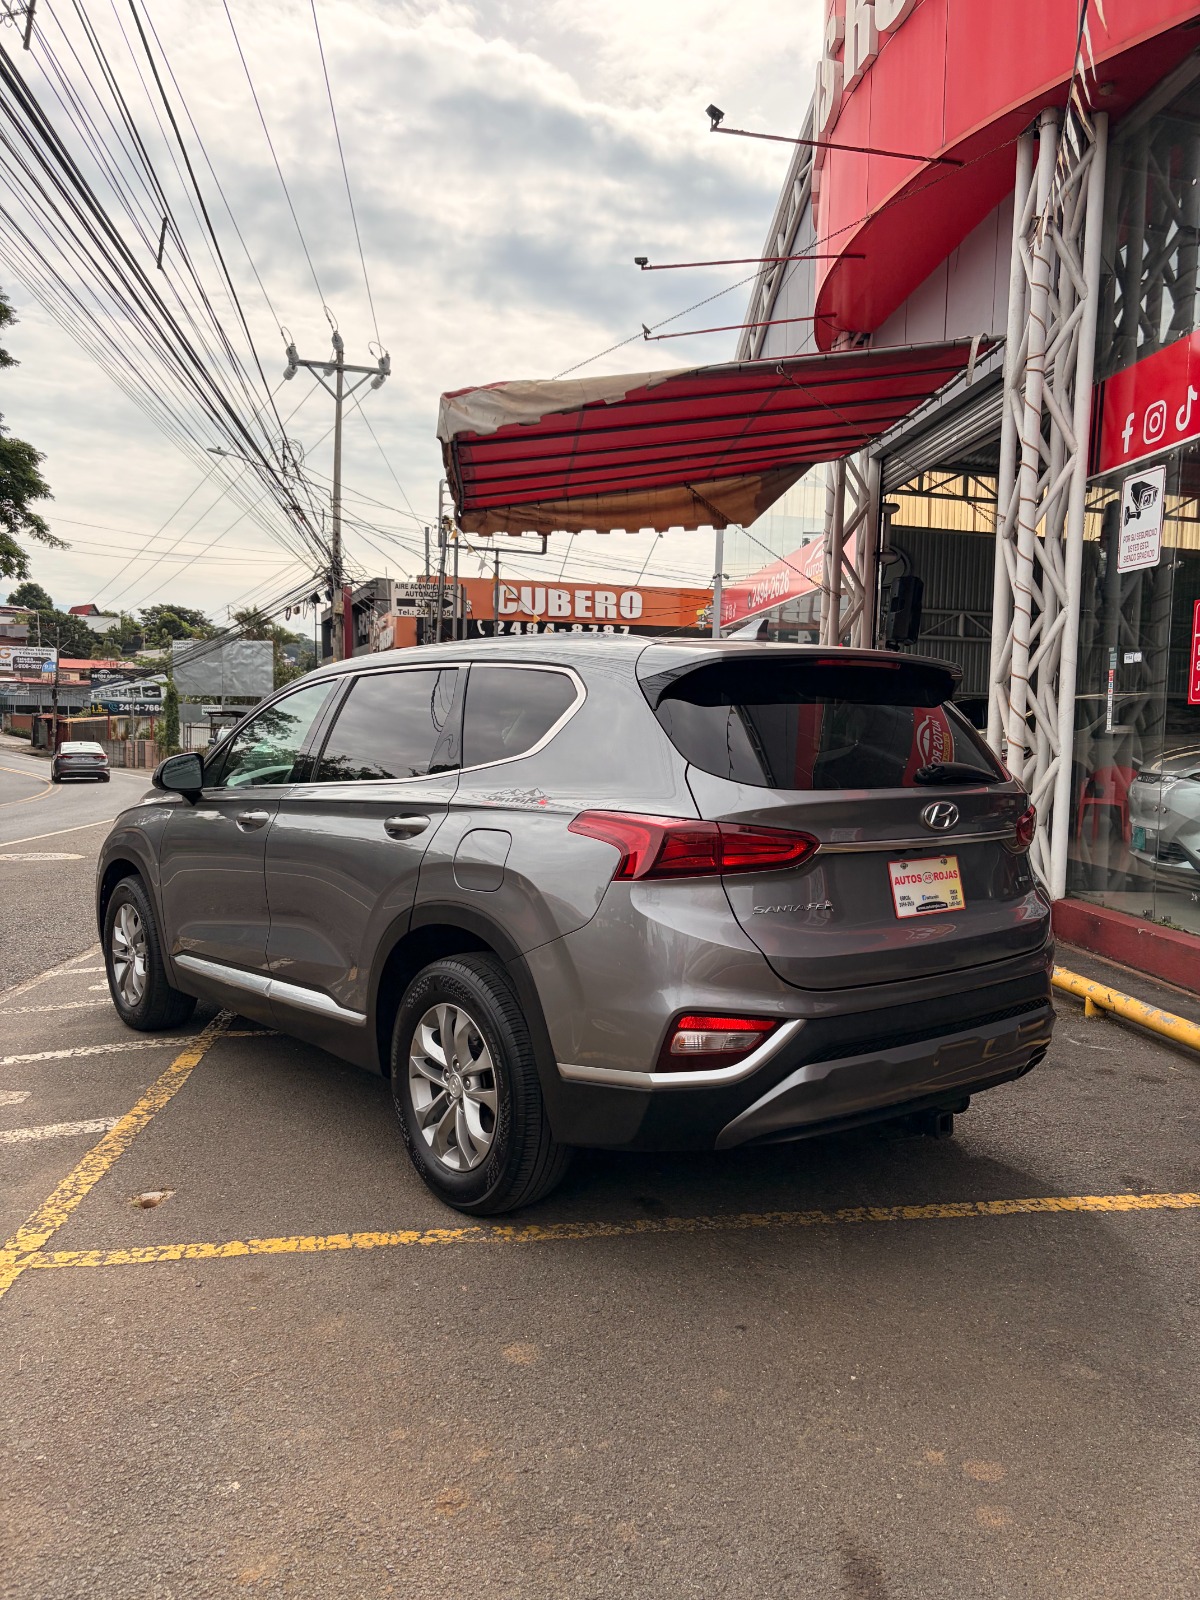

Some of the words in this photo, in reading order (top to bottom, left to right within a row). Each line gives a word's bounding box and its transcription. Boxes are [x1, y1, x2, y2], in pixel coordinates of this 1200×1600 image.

[493, 584, 643, 619] CUBERO
[894, 873, 922, 885] AUTOS
[932, 869, 958, 881] ROJAS
[752, 904, 805, 915] SANTA
